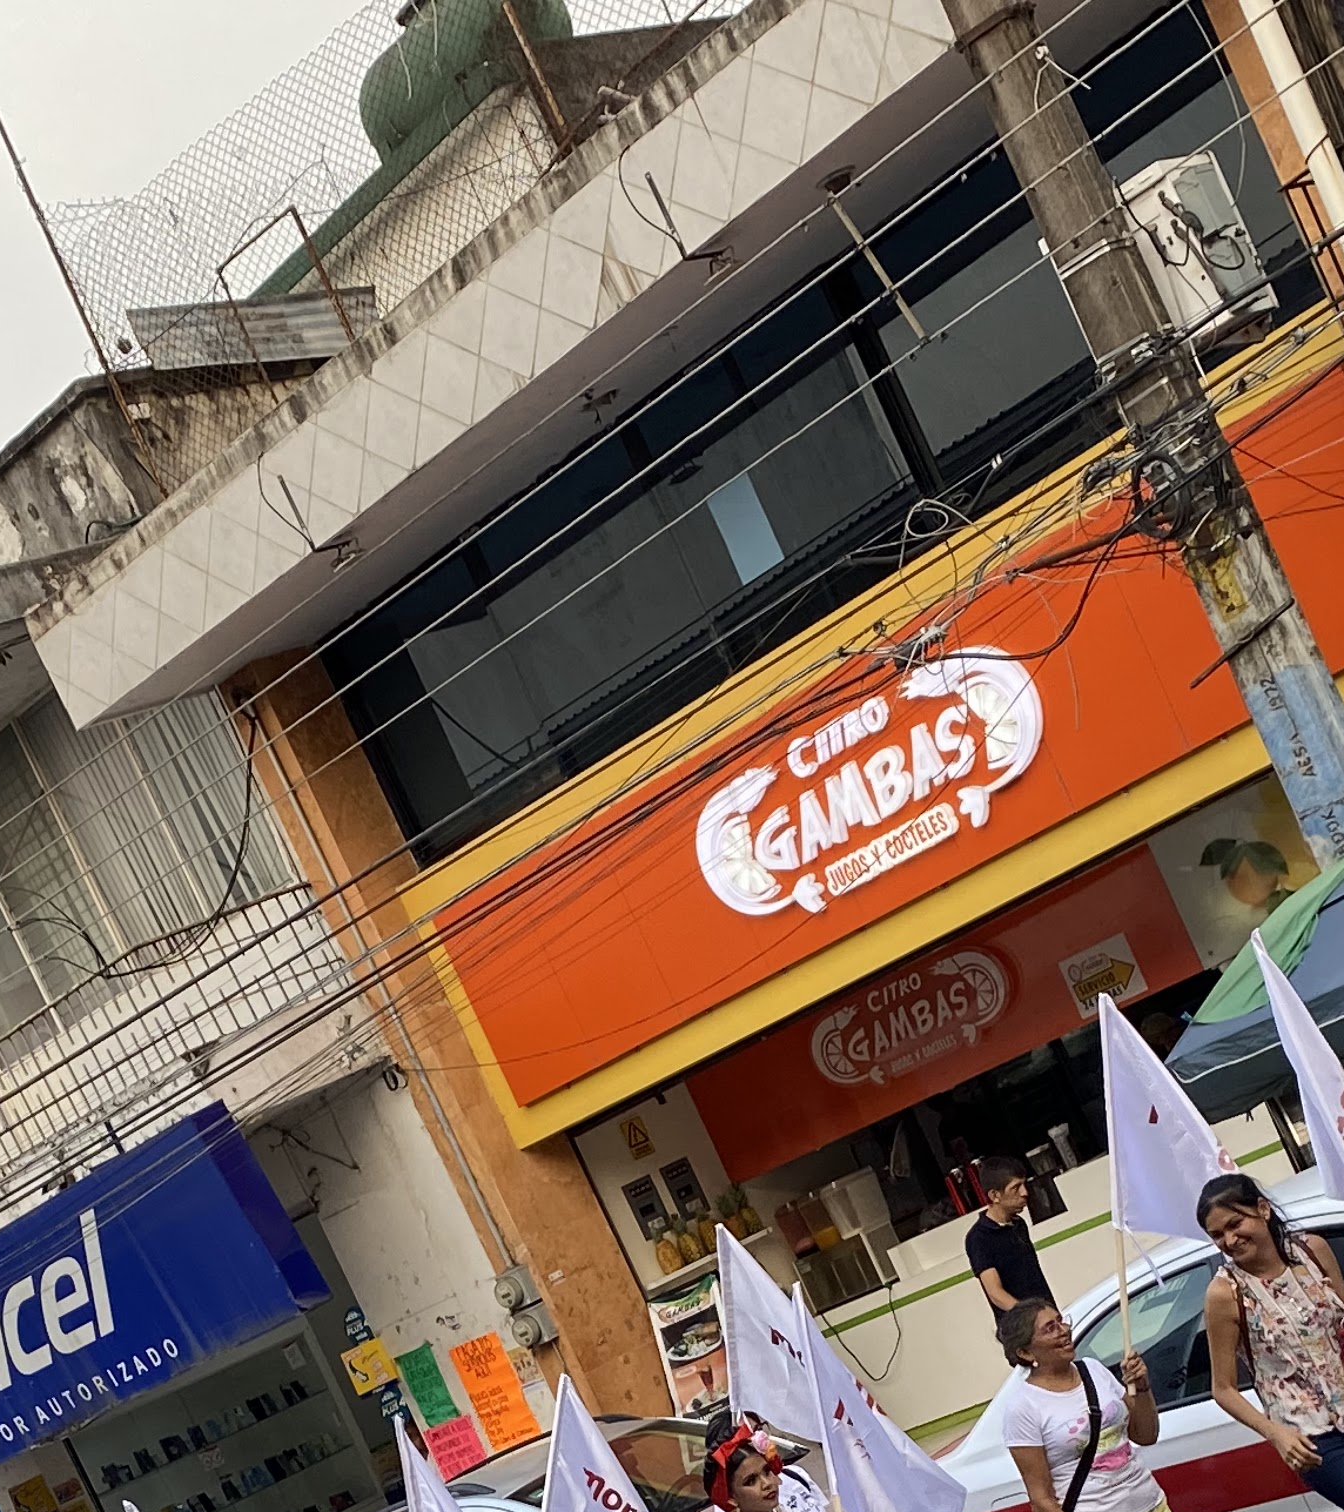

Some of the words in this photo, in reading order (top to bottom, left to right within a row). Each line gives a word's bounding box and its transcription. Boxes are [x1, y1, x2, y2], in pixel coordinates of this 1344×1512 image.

[786, 696, 890, 779] CITRO
[754, 704, 977, 871] GAMBAS
[828, 854, 871, 891] JUGOS
[872, 845, 883, 867] Y
[885, 810, 948, 860] COCTELES
[847, 981, 969, 1061] GAMBAS
[866, 972, 922, 1012] CITRO
[35, 1336, 180, 1425] AUTORIZADO
